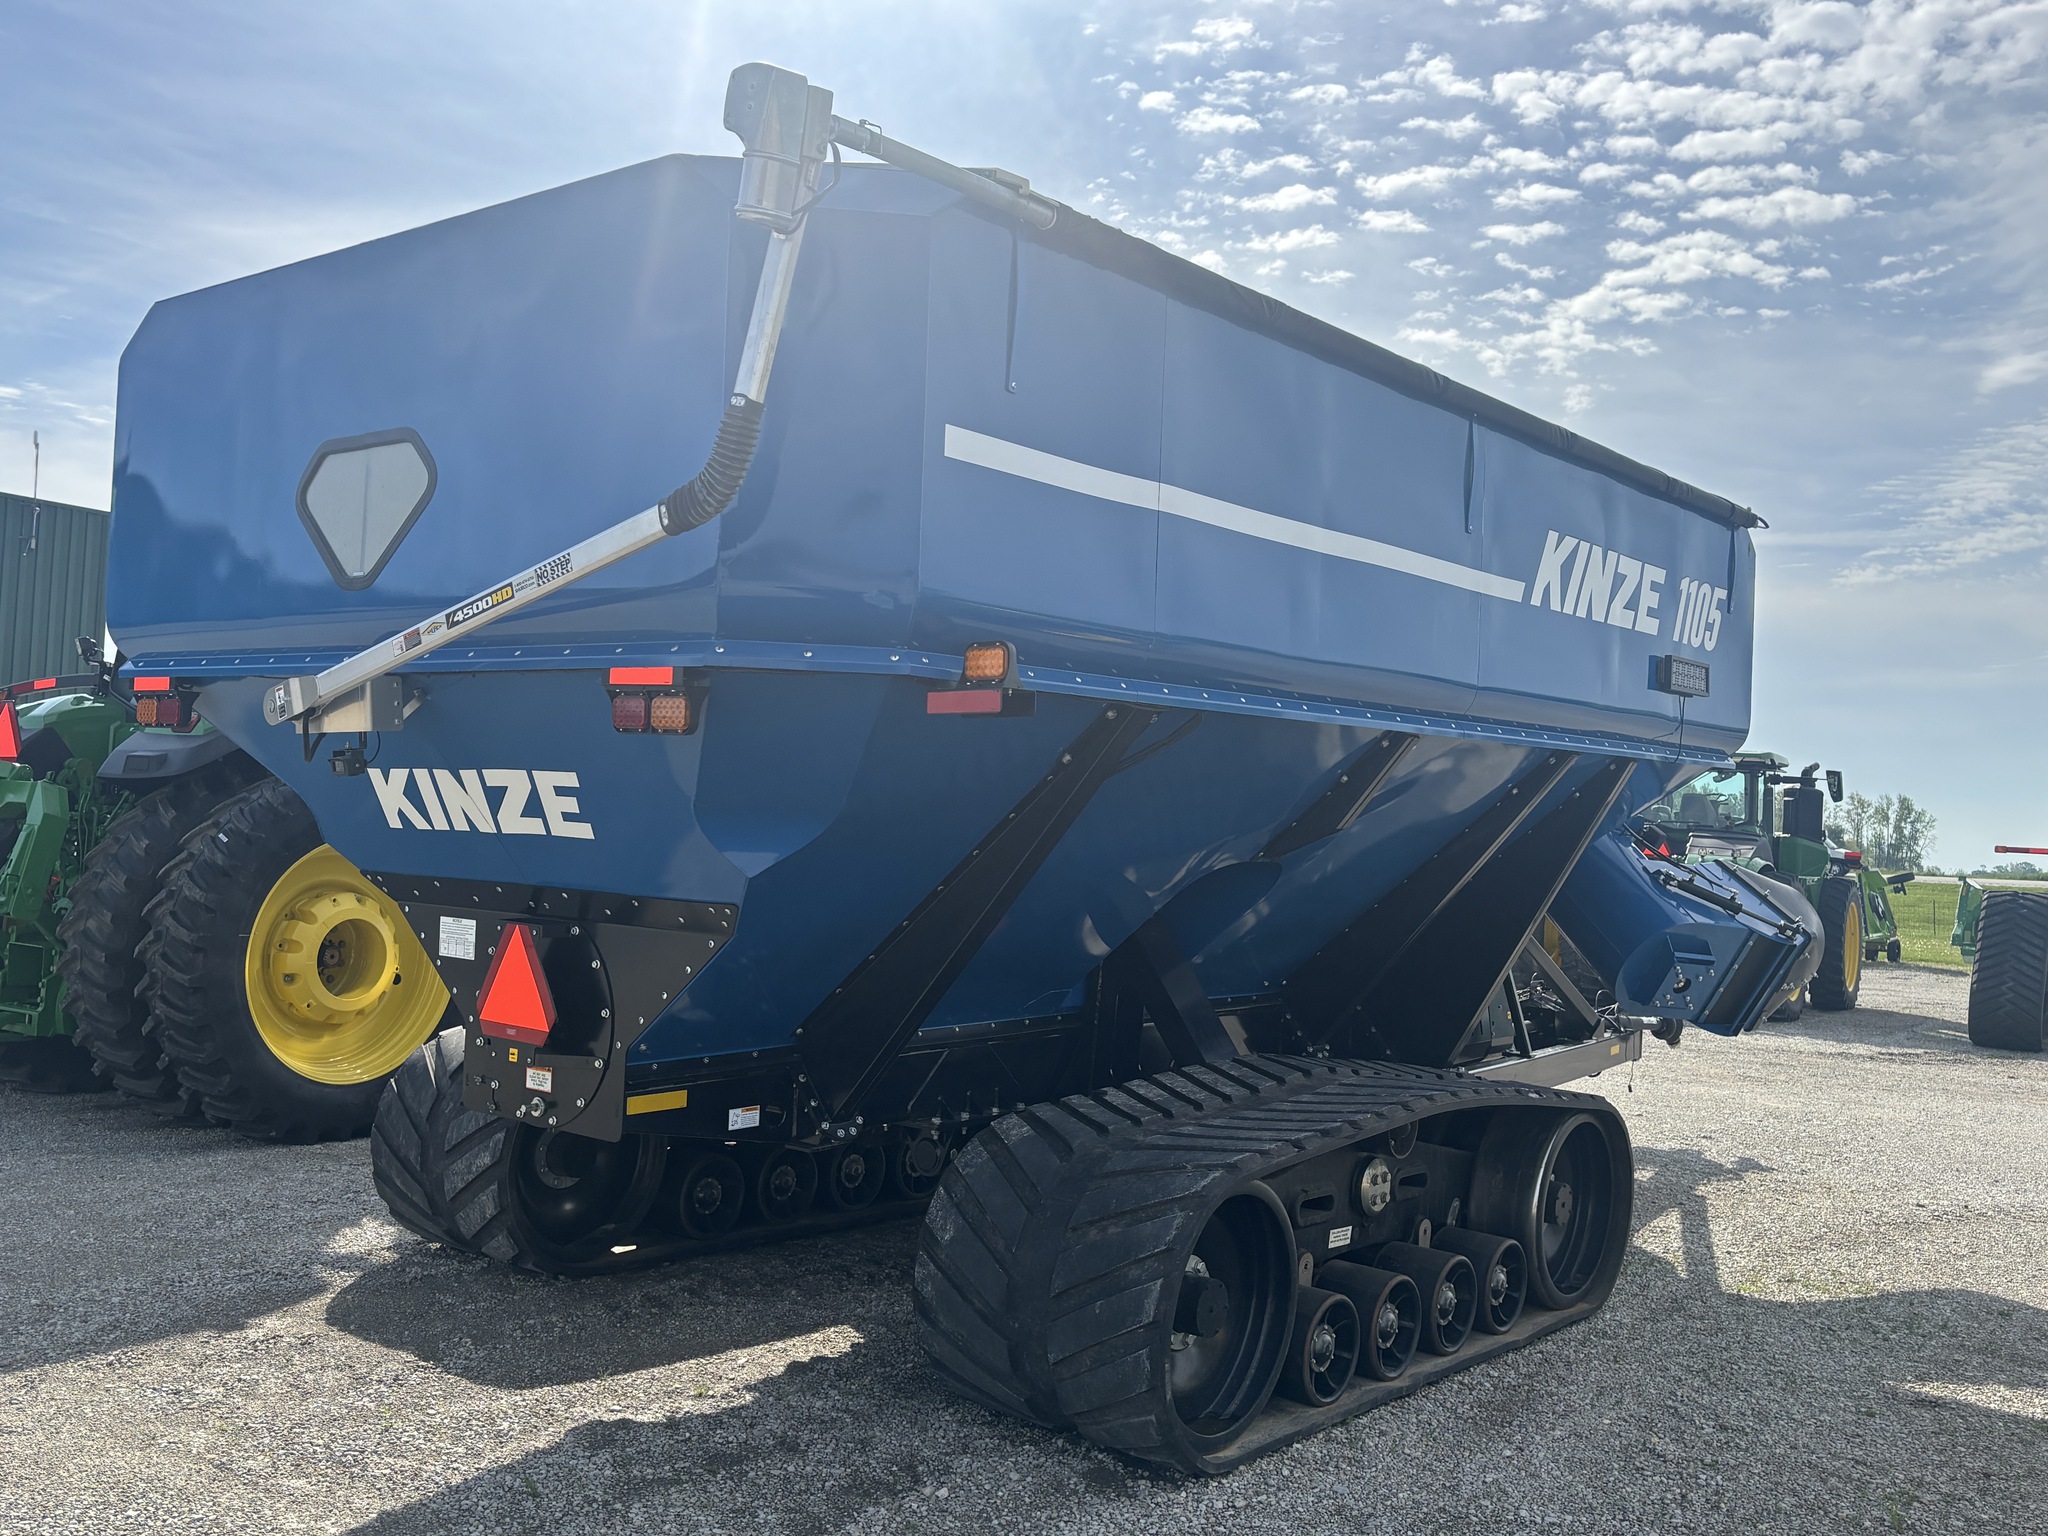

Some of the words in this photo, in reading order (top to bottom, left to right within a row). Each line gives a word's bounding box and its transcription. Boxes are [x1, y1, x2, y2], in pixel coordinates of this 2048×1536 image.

[536, 569, 549, 582] NO
[549, 558, 571, 576] STEP
[1530, 529, 1667, 636] KINZE
[1673, 576, 1728, 651] 1105
[453, 586, 513, 622] 4500HD
[366, 768, 595, 840] KINZE
